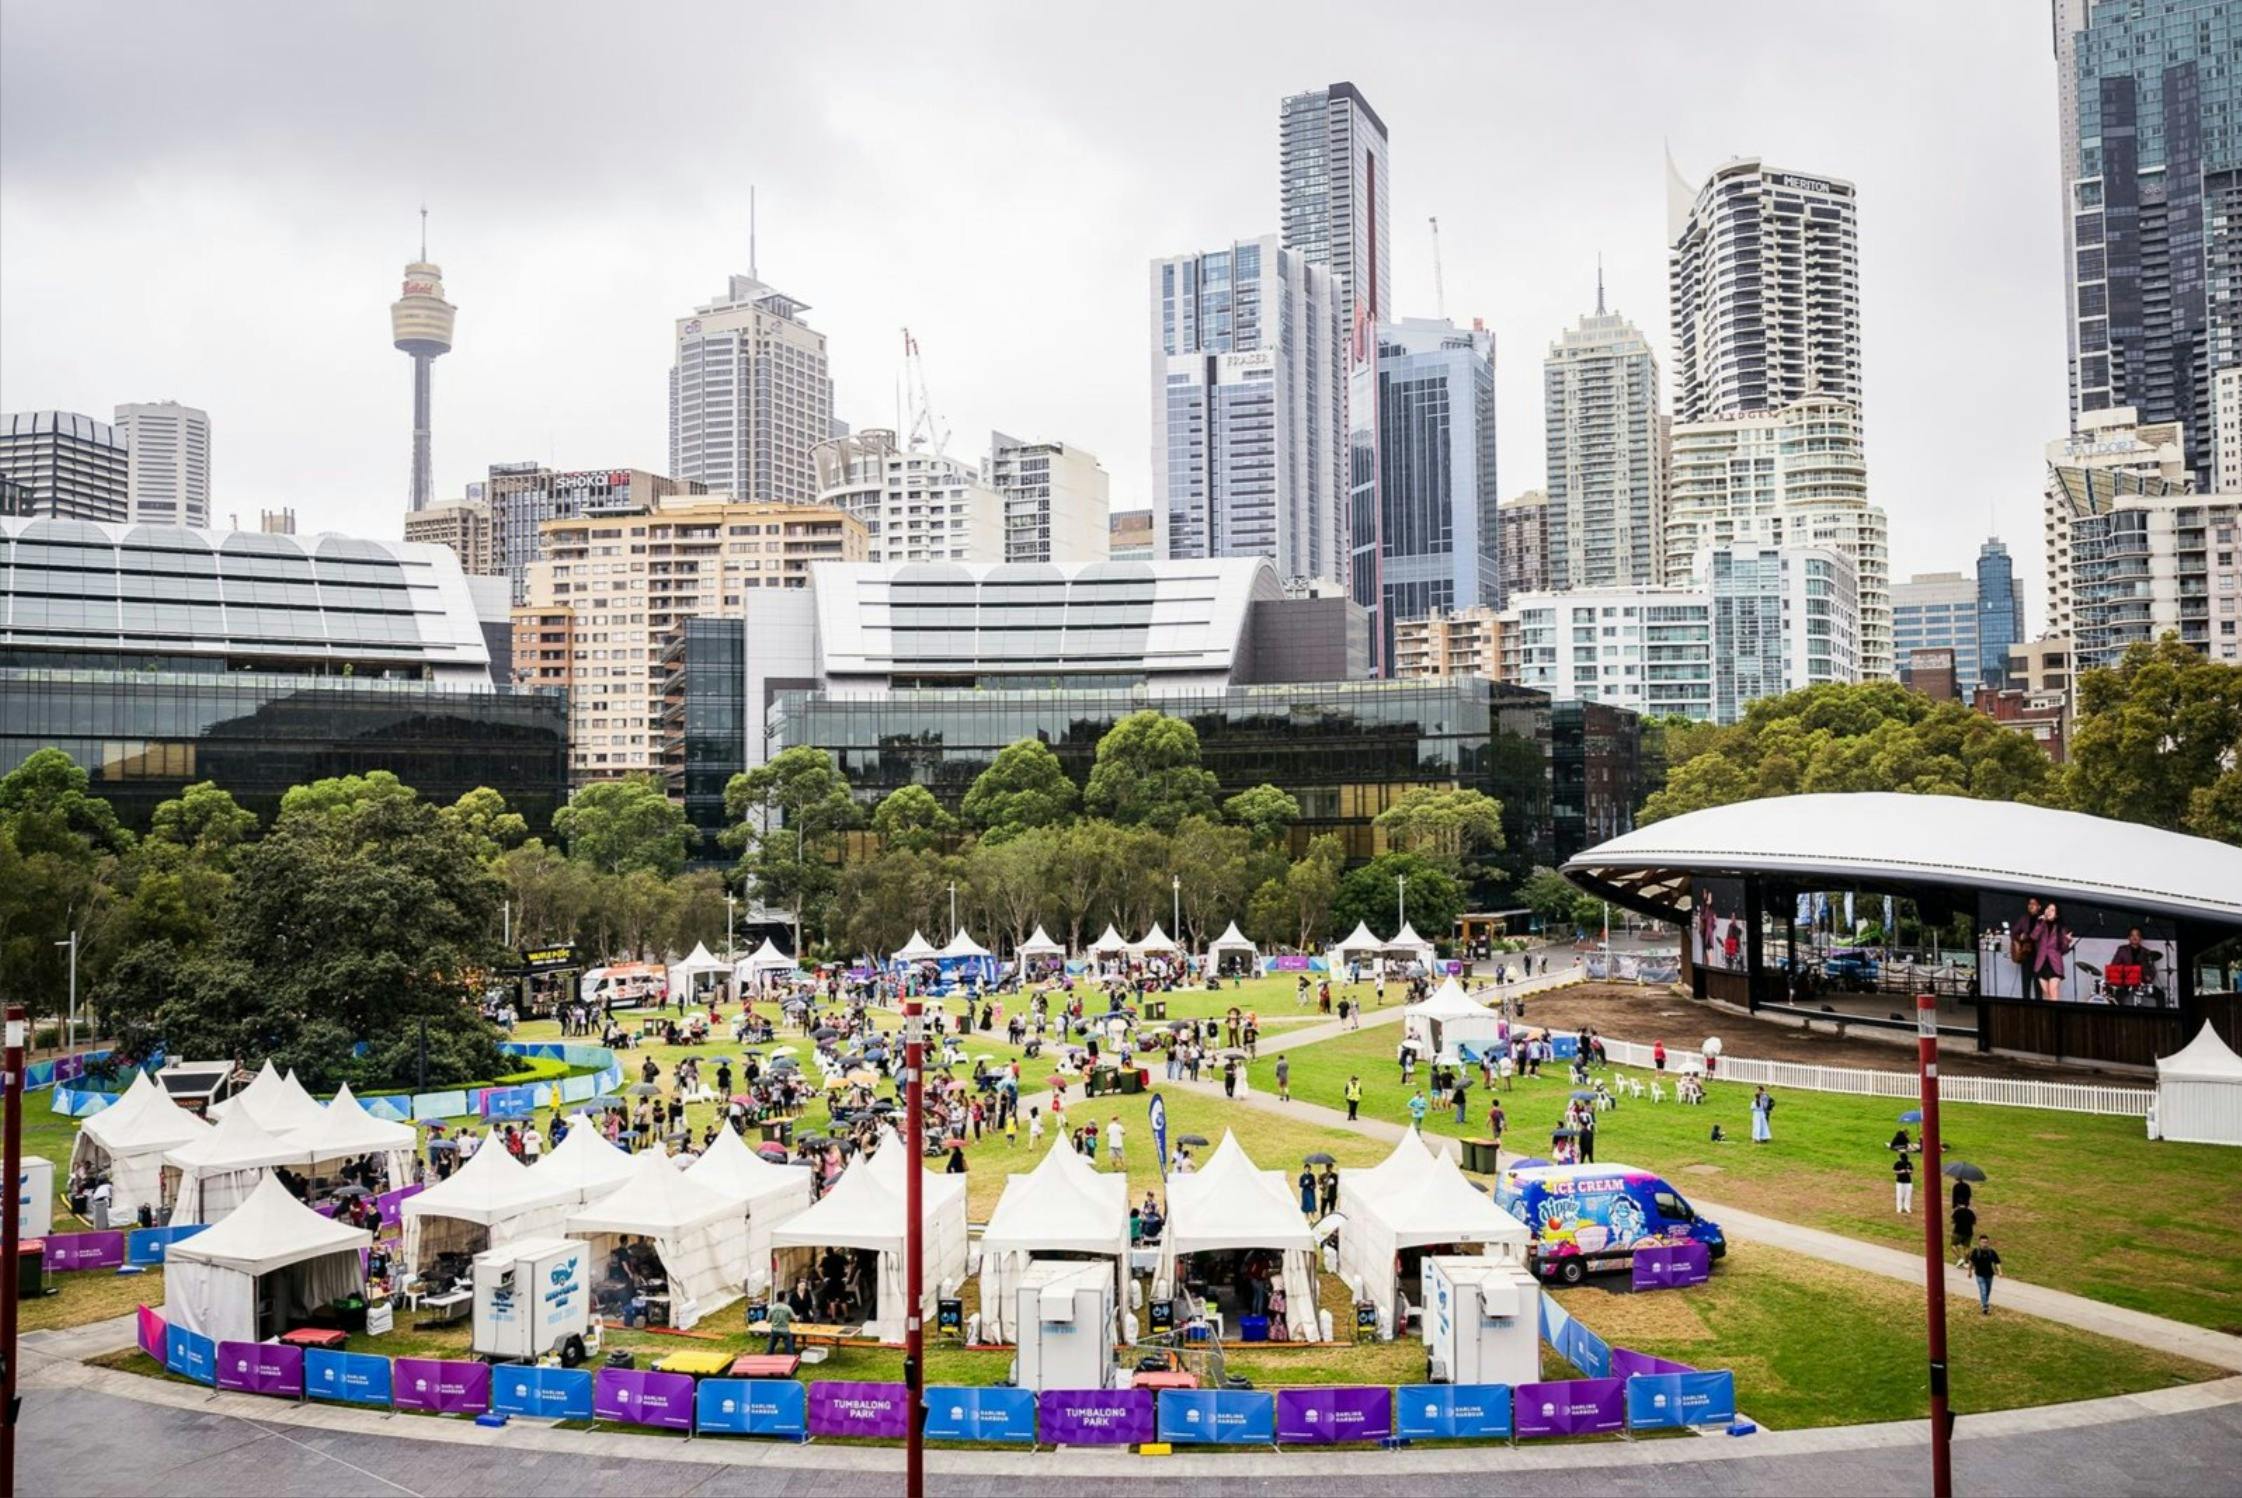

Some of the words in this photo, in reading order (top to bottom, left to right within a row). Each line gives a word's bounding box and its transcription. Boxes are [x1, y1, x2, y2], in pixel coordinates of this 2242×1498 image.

[1784, 175, 1830, 193] MERITON
[1553, 1182, 1576, 1196] ICE
[1577, 1179, 1625, 1193] CREAM
[833, 1399, 891, 1410] TUMBALONG
[850, 1409, 875, 1418] PARK
[1066, 1408, 1126, 1417] TUMBALONG
[1083, 1417, 1110, 1426] PARK
